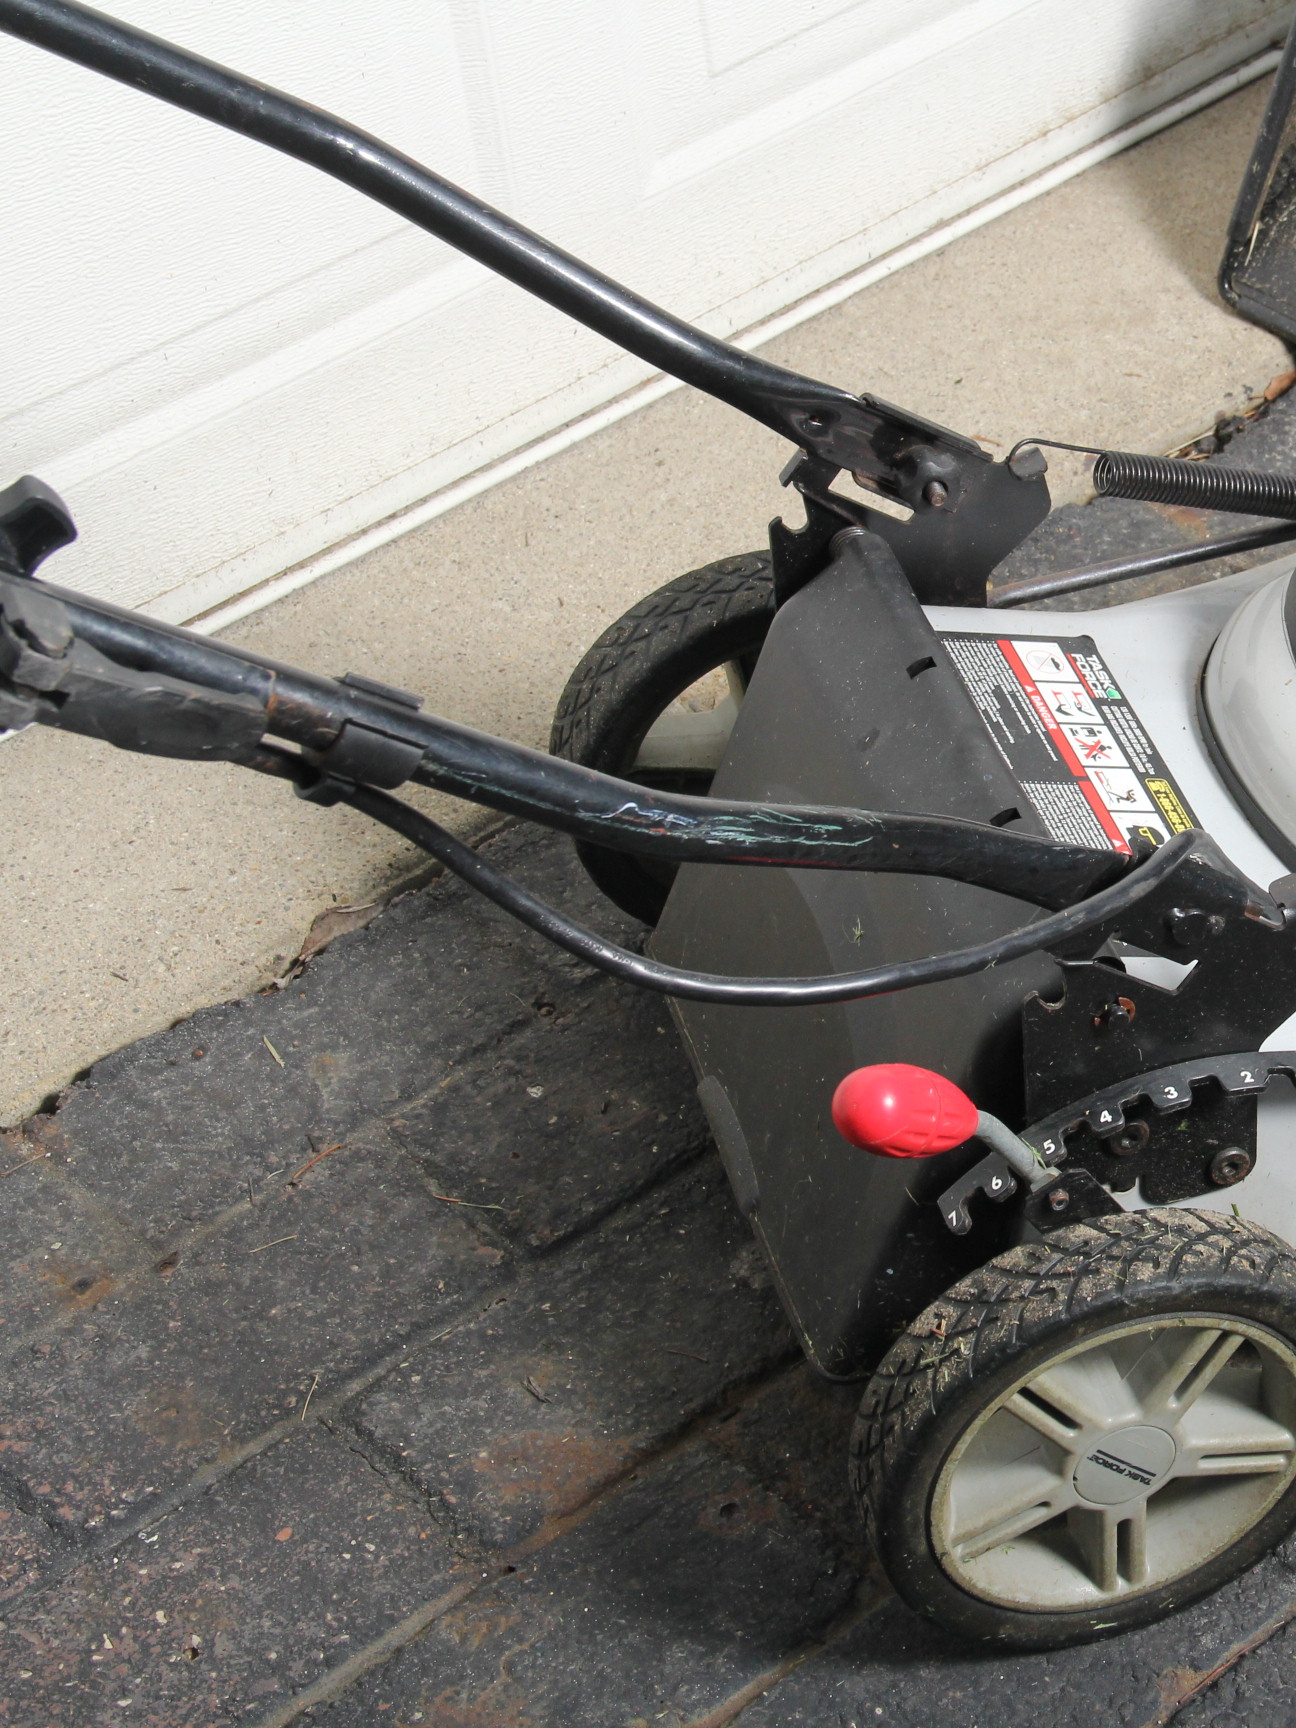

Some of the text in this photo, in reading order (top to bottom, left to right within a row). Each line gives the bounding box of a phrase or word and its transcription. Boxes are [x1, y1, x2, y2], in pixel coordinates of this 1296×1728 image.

[1072, 653, 1106, 700] FORCE
[1085, 655, 1115, 694] TASK
[1030, 695, 1057, 730] DANGER
[1240, 1070, 1255, 1083] 2
[1164, 1086, 1178, 1099] 3
[1099, 1109, 1113, 1123] 4
[1043, 1139, 1056, 1154] 5
[991, 1176, 1002, 1190] 6
[948, 1211, 958, 1226] 7
